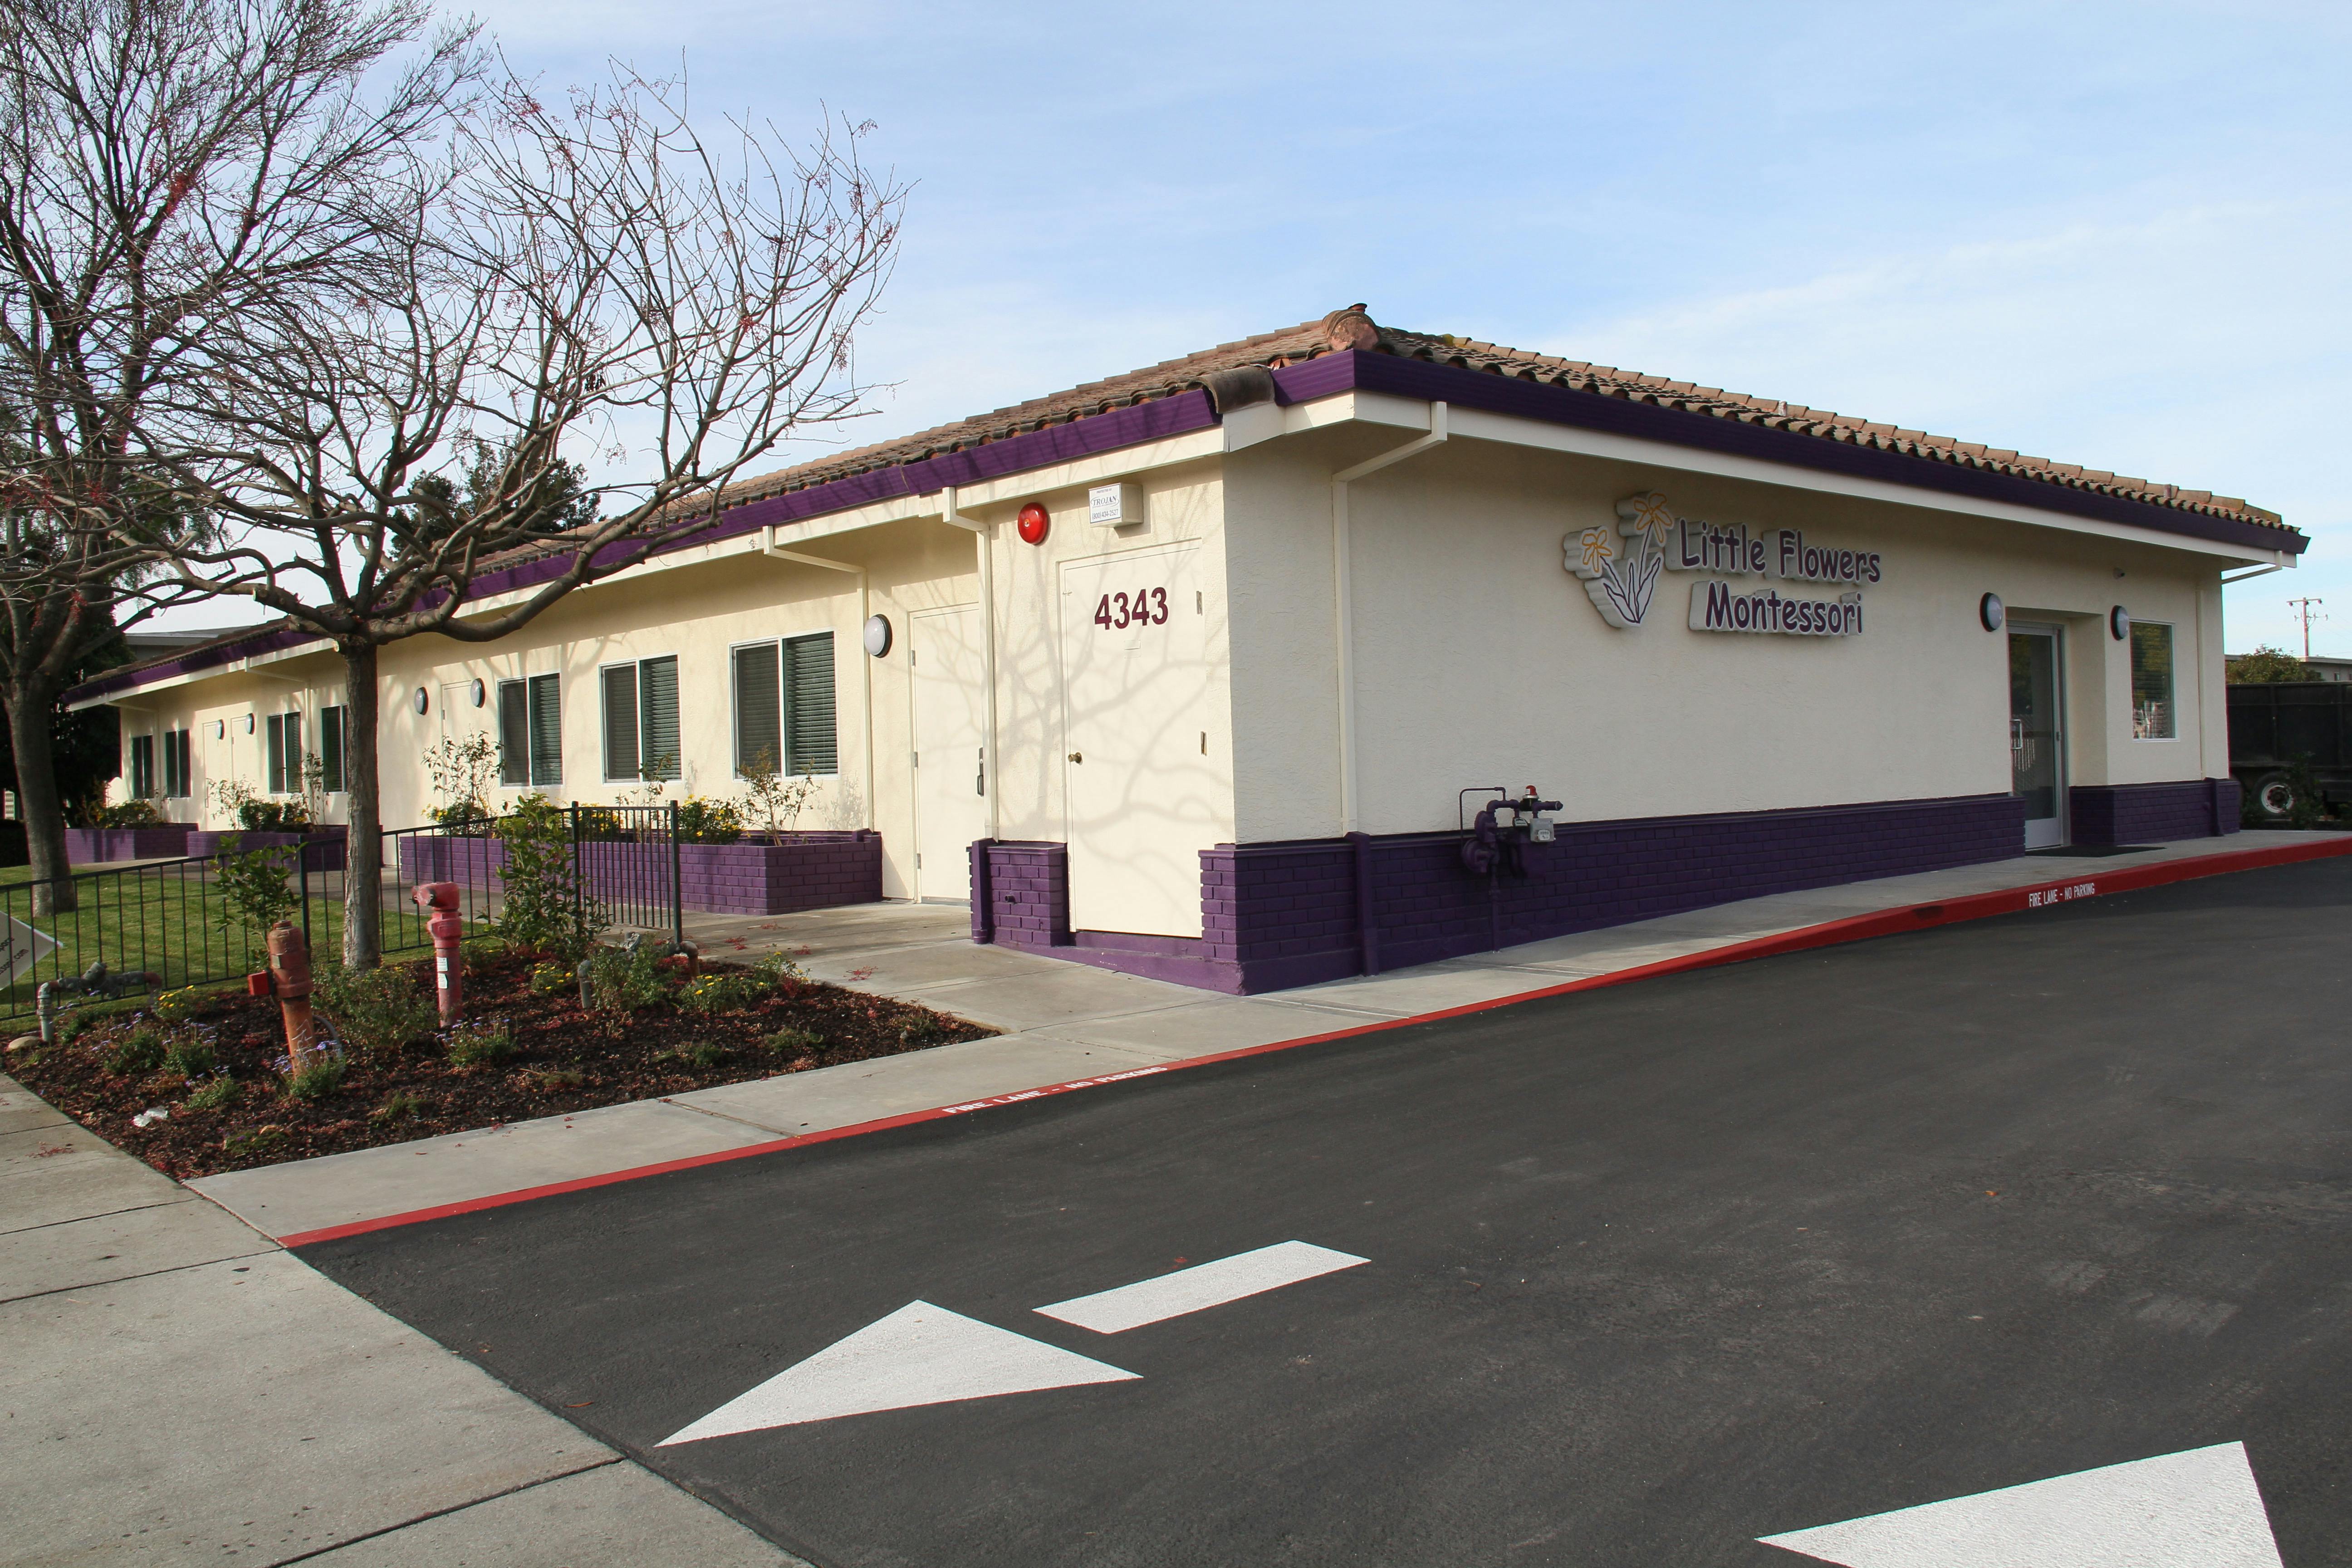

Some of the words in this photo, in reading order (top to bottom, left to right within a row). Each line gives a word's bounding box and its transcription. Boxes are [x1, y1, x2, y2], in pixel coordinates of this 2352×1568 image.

[1092, 511, 1102, 520] (800)
[1102, 509, 1118, 518] 434-2527
[1093, 495, 1117, 506] TROJAN
[1680, 519, 1766, 572] Little
[1779, 529, 1881, 583] Flowers
[1094, 587, 1168, 630] 4343
[1705, 582, 1862, 634] Montessori
[2029, 892, 2042, 907] FIRE
[2043, 889, 2058, 904] LANE
[2064, 887, 2072, 900] NO
[2074, 882, 2095, 898] PARKING
[942, 1102, 994, 1113] FIRE
[992, 1090, 1048, 1103] LANE
[1094, 1067, 1168, 1083] PARKING
